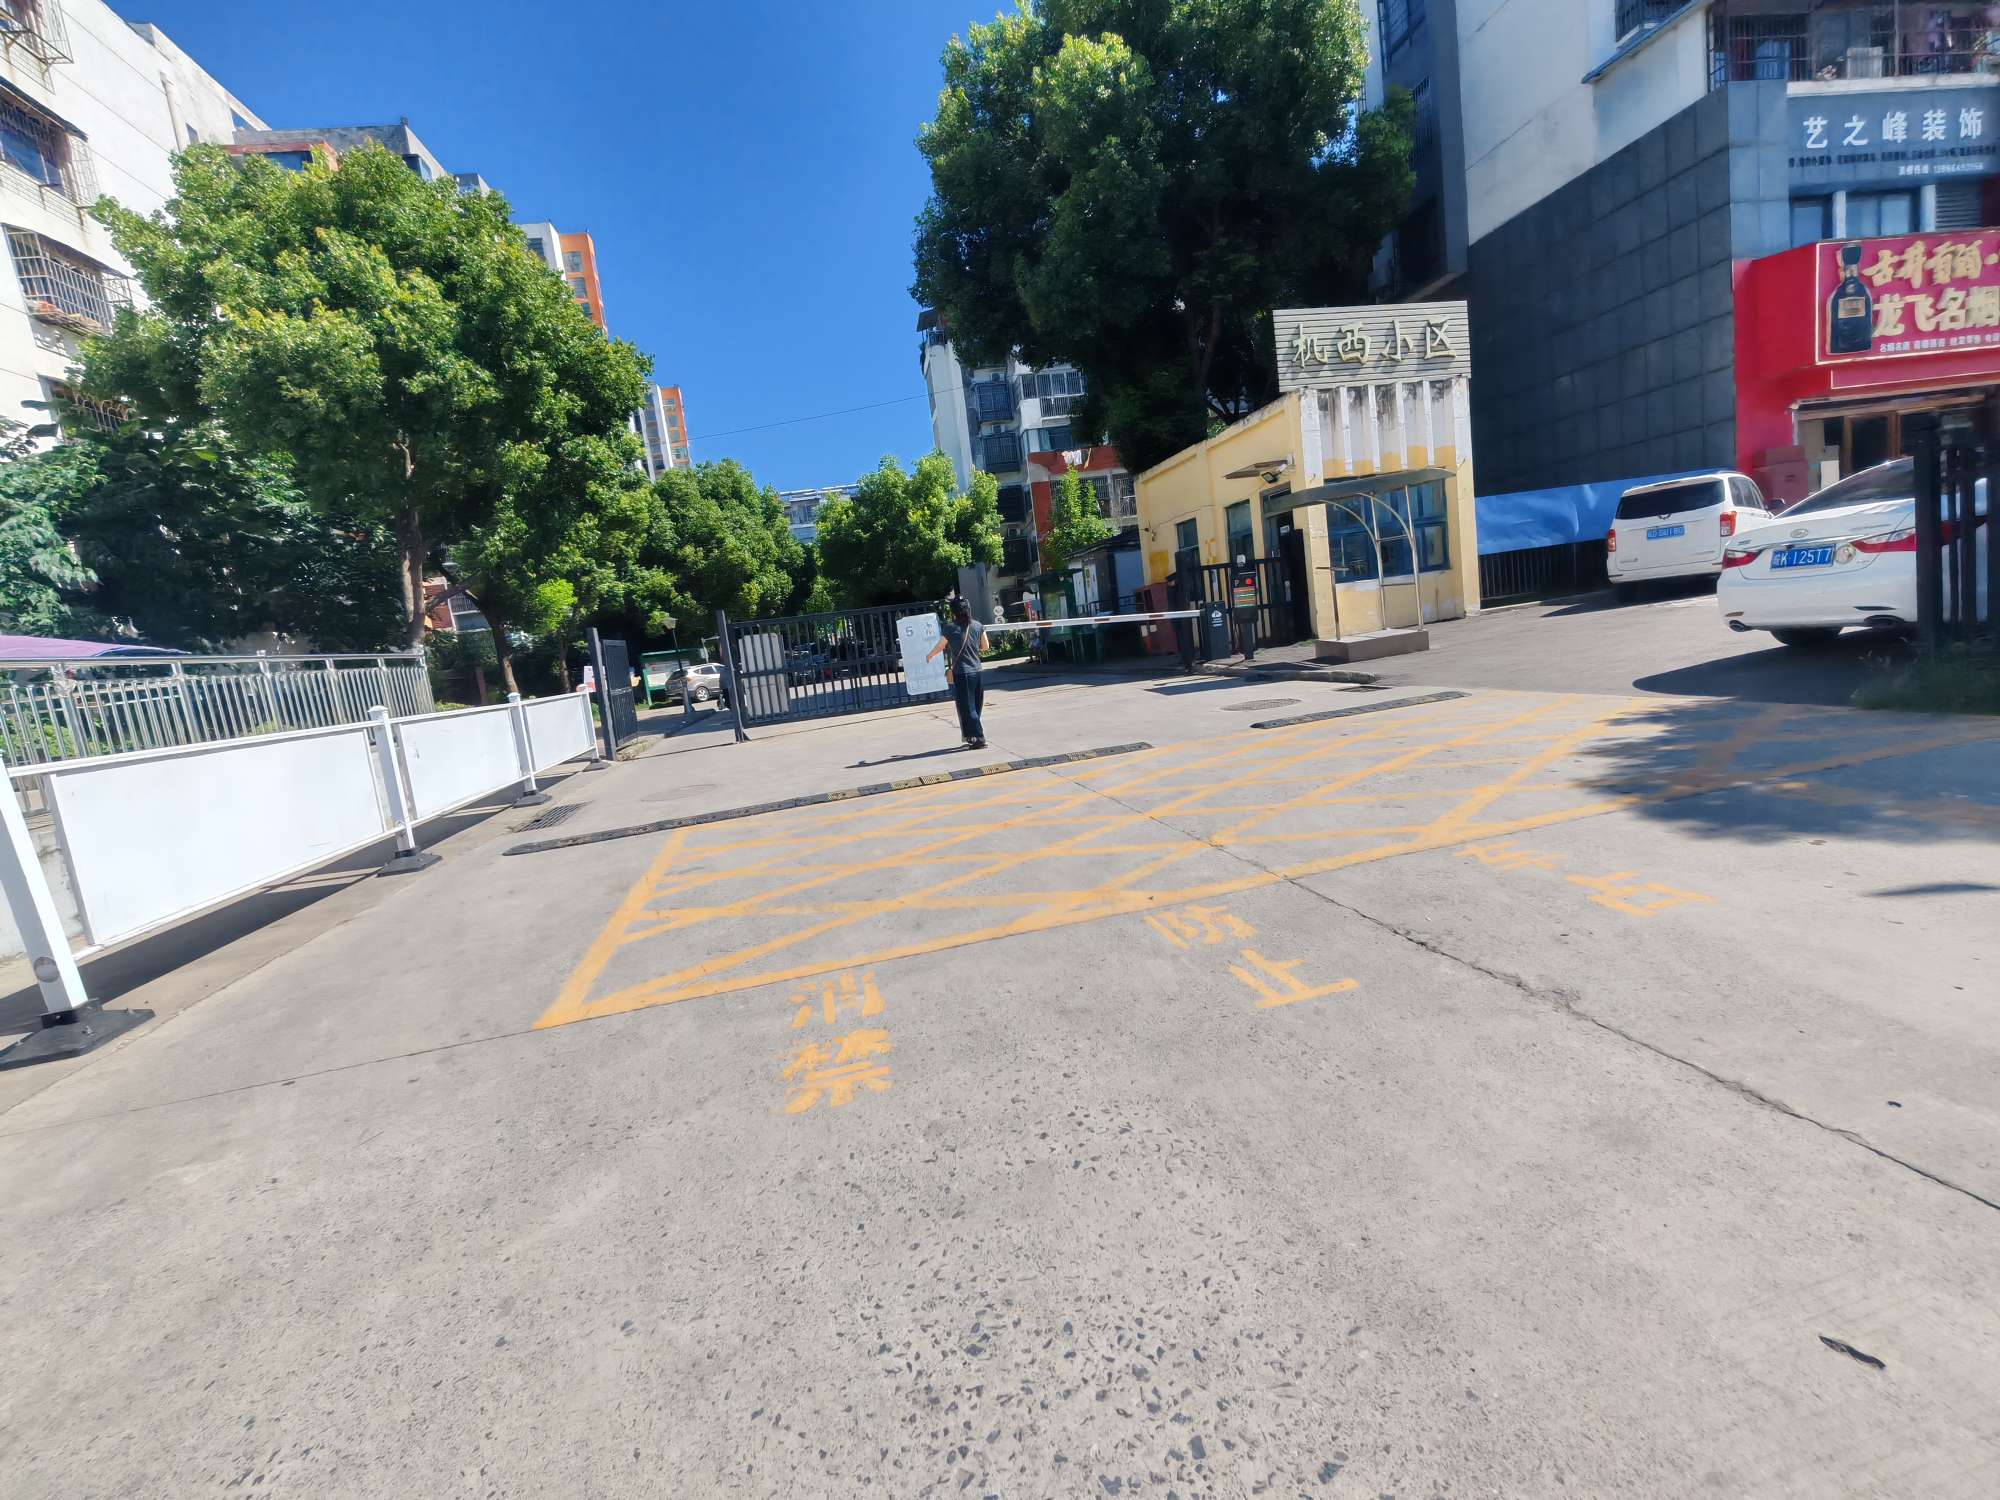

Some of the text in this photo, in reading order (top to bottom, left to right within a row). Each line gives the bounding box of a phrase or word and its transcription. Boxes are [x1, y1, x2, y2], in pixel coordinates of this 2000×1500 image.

[1803, 107, 1985, 149] 艺之峰装饰
